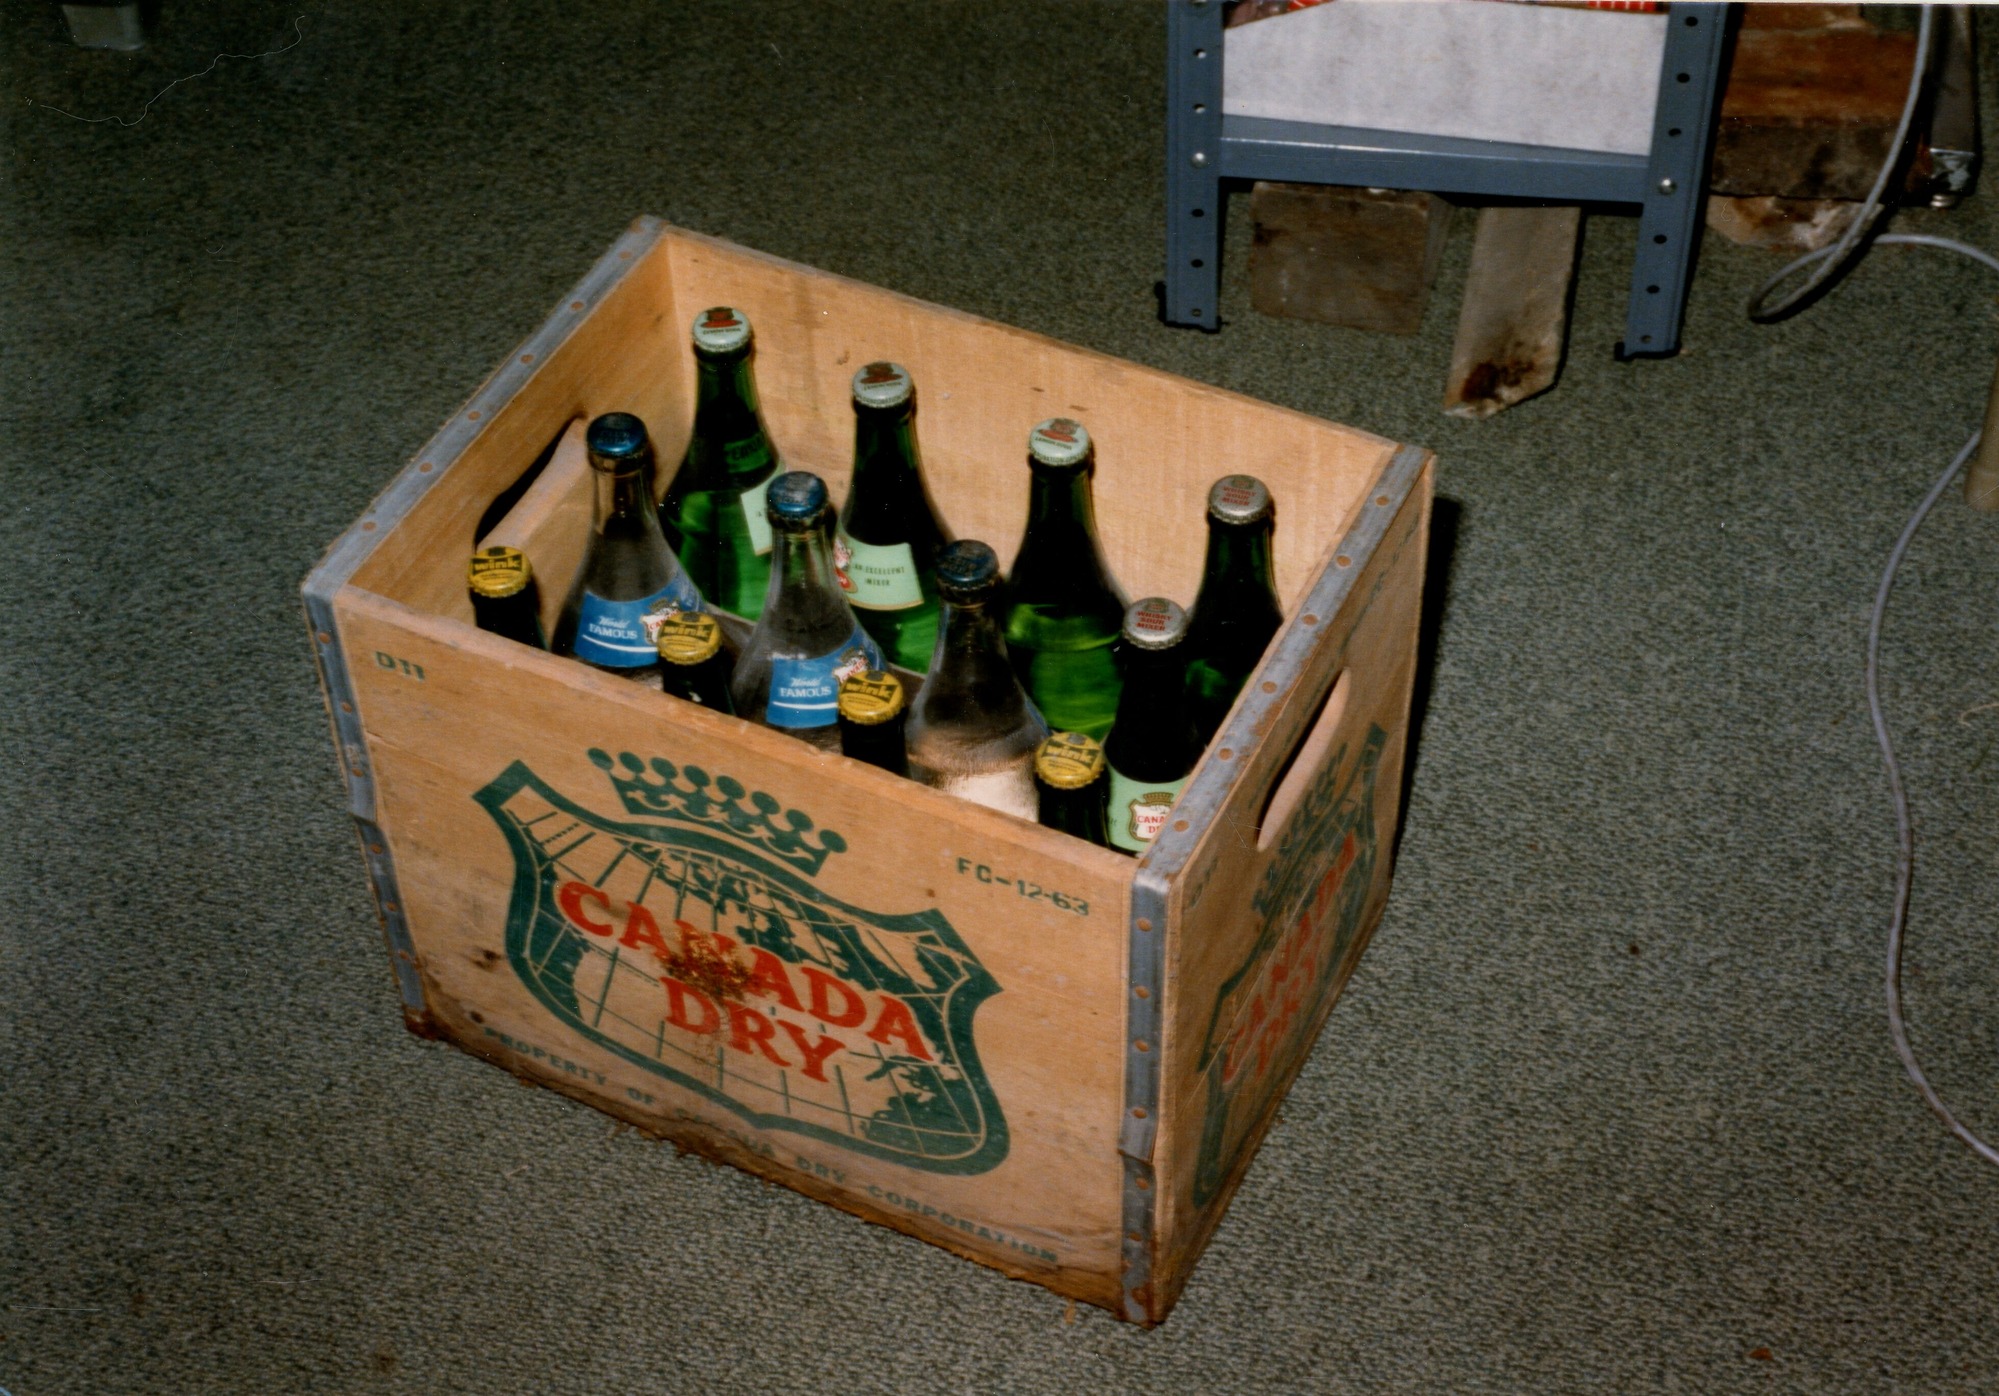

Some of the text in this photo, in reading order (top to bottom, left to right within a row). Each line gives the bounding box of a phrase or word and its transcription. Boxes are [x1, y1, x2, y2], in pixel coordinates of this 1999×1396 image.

[475, 557, 520, 571] wink
[588, 623, 638, 640] FAMOUS
[664, 624, 710, 639] wink
[779, 685, 832, 698] FAMOUS
[845, 680, 893, 699] wink
[1046, 744, 1093, 764] wink
[1137, 815, 1165, 824] CANA
[660, 976, 848, 1083] DRY
[795, 1155, 846, 1184] DRY
[866, 1184, 1058, 1263] CORPORATION
